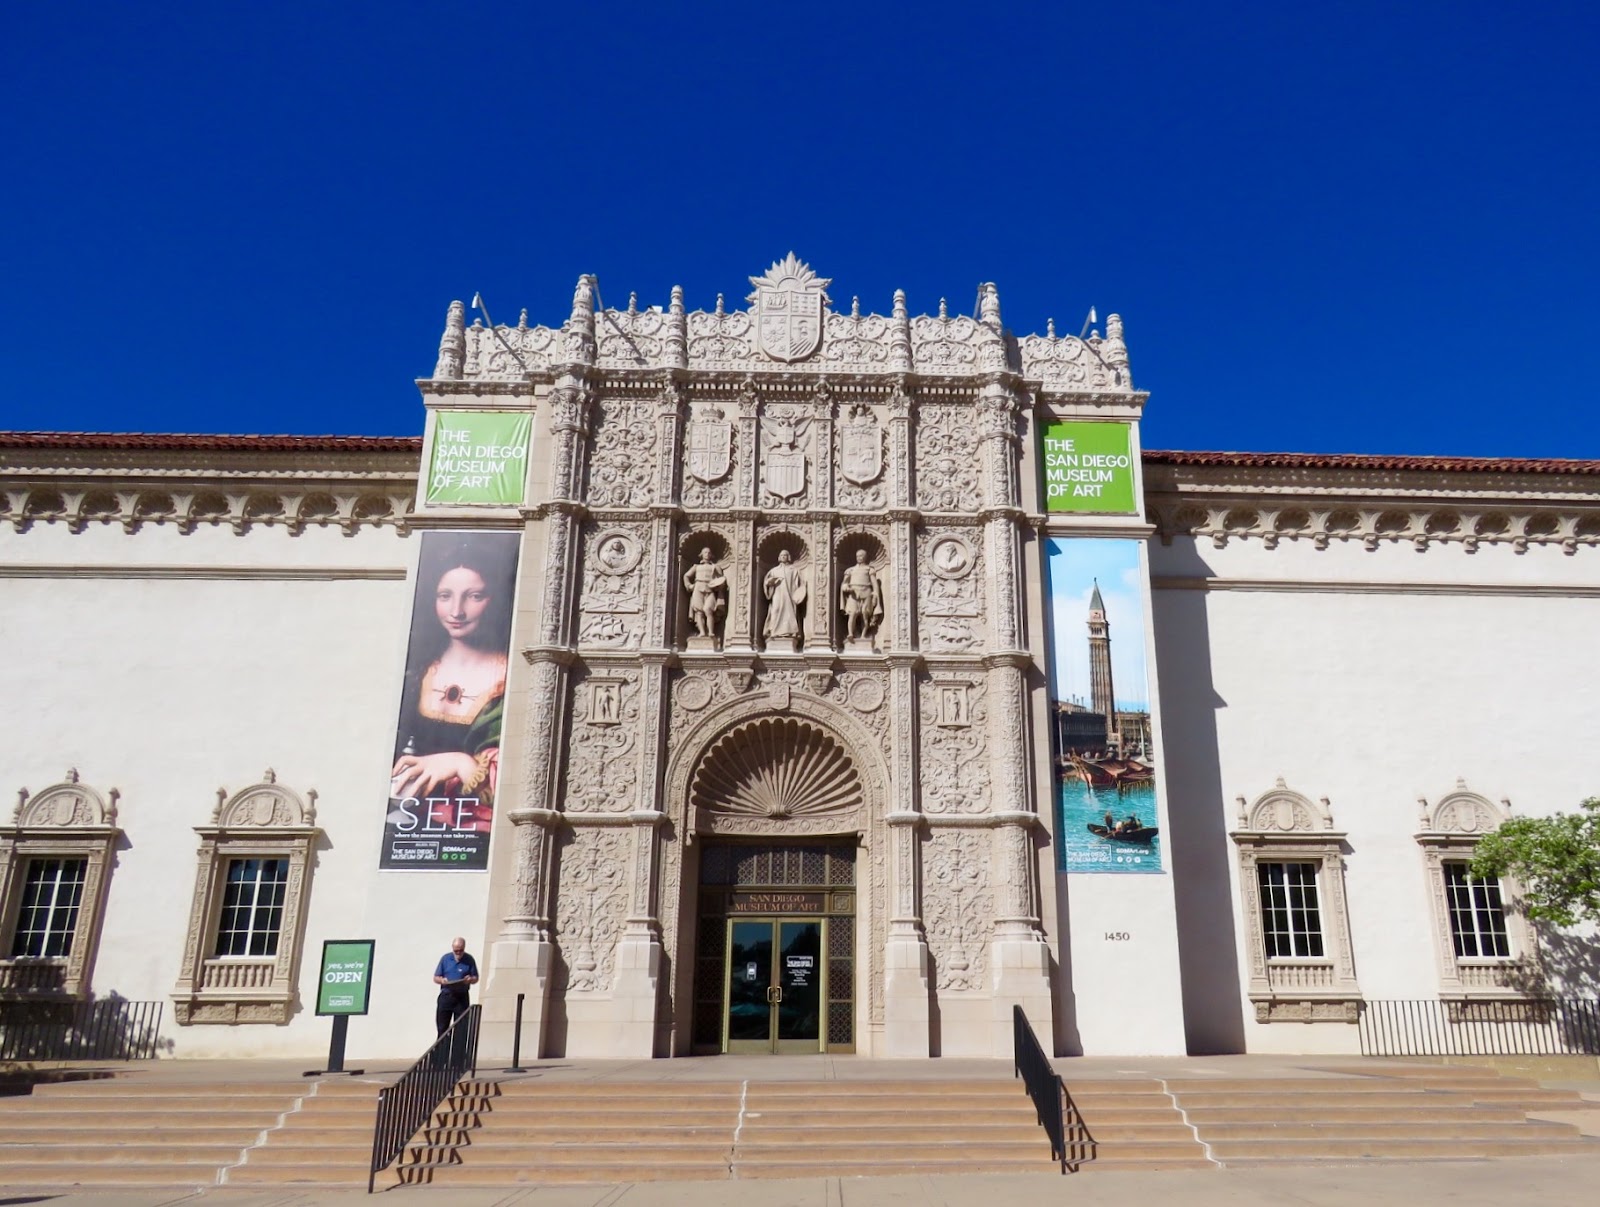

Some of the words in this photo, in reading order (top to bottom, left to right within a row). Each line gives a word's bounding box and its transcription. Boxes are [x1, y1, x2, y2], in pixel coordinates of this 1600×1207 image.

[440, 430, 471, 443] THE
[438, 445, 471, 458] SAN
[475, 446, 524, 459] DIEGO
[1044, 439, 1075, 452] THE
[436, 460, 506, 473] MUSEUM
[1046, 454, 1078, 467] SAN
[1082, 455, 1129, 468] DIEGO
[434, 475, 456, 488] OF
[460, 476, 493, 489] ART
[1047, 469, 1113, 482] MUSEUM
[1048, 484, 1069, 496] OF
[1073, 485, 1103, 497] ART
[396, 797, 479, 831] SEE
[735, 903, 780, 911] MUSEUM
[782, 903, 794, 911] OF
[799, 903, 818, 911] ART
[1104, 932, 1130, 941] 1450
[327, 962, 343, 971] yes,
[344, 961, 364, 969] we're
[325, 972, 363, 983] OPEN
